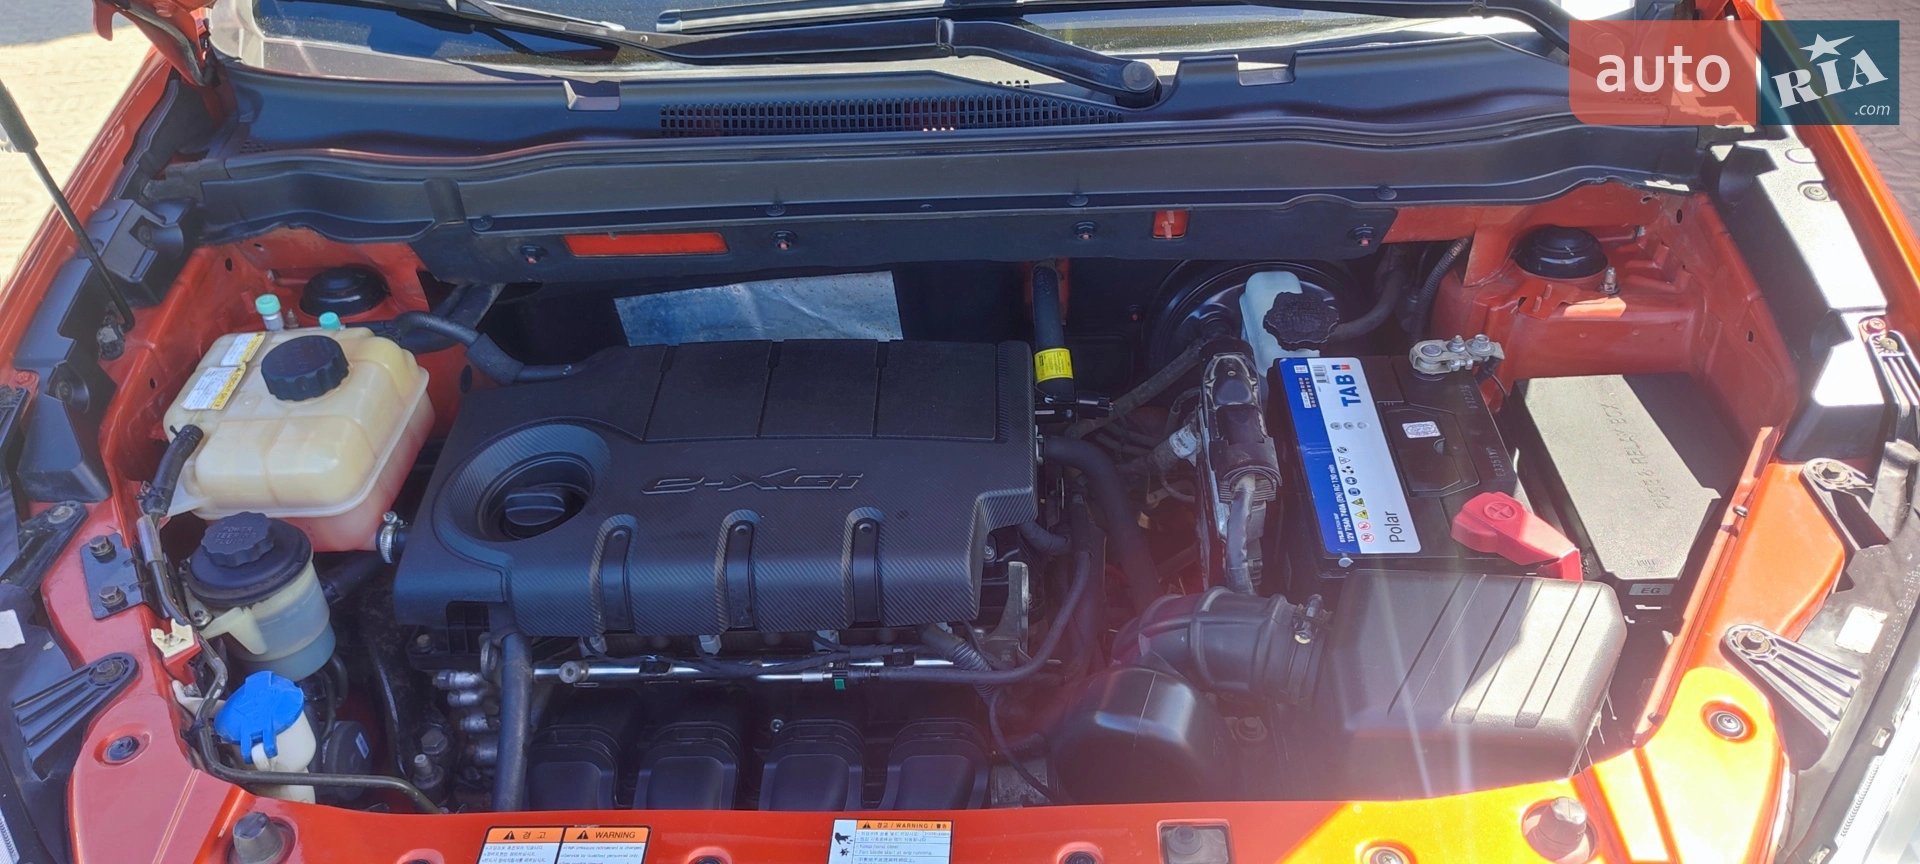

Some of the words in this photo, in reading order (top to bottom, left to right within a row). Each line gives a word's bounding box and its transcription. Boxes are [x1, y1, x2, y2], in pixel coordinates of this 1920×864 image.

[1335, 374, 1362, 407] TAB
[1384, 510, 1406, 543] Polar
[594, 831, 636, 839] WARNING
